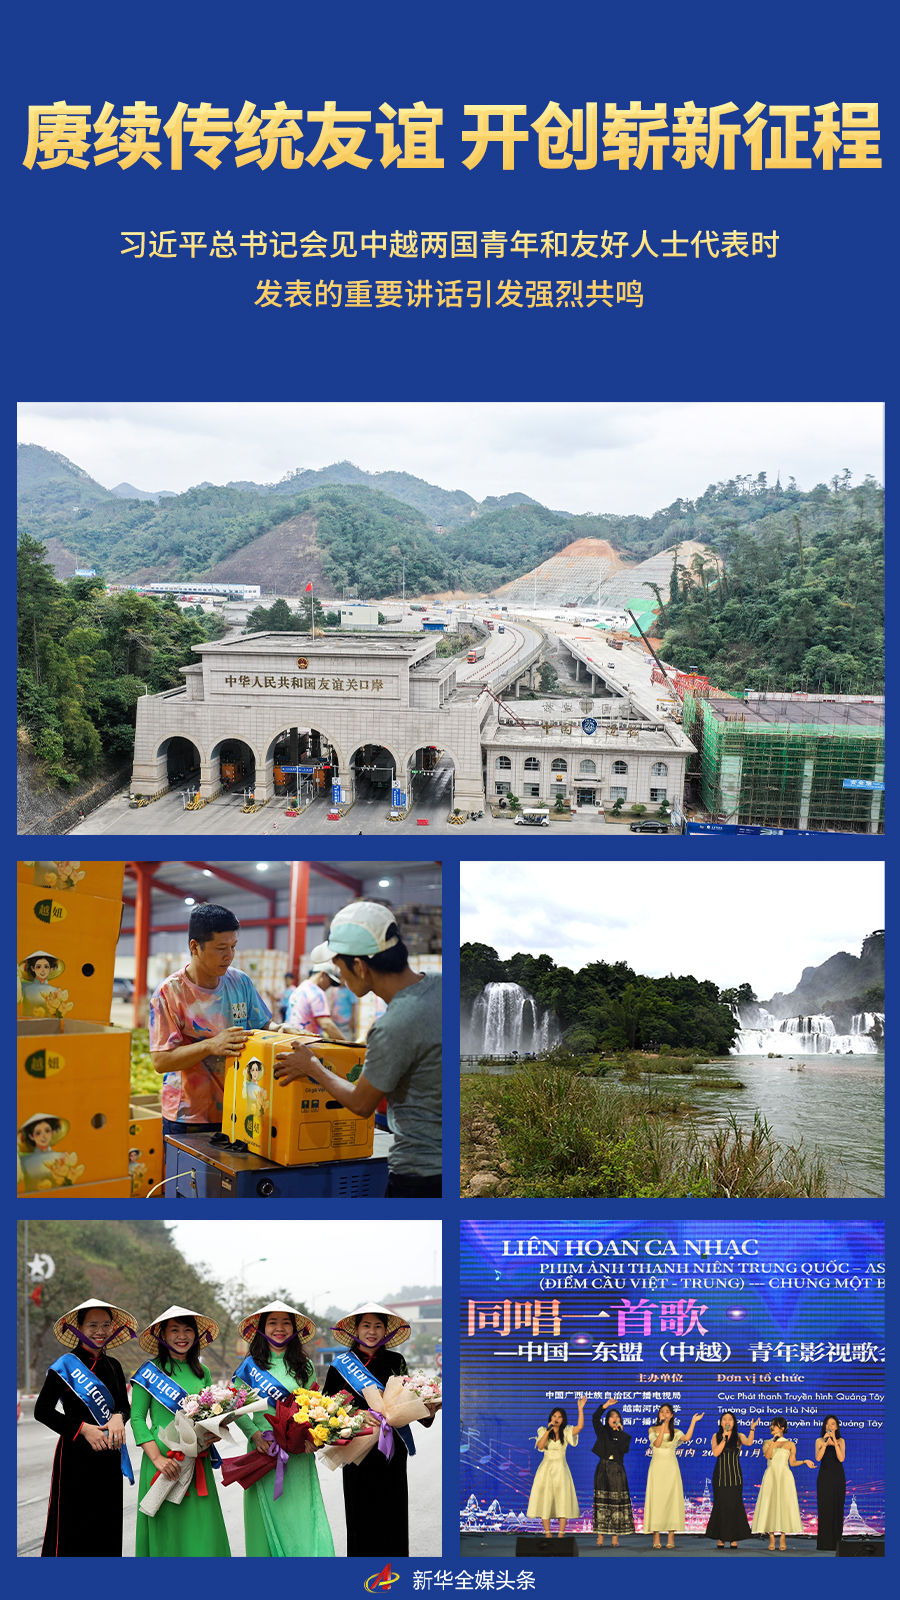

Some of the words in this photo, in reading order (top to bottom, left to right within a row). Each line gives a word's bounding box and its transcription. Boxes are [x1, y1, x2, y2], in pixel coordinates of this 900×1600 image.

[225, 675, 384, 692] 中华人民共和国友谊关口岸
[501, 1236, 560, 1256] LIÊN
[564, 1239, 640, 1256] HOAN
[644, 1239, 680, 1256] CA
[683, 1239, 759, 1259] NHẠC
[539, 1263, 584, 1274] PHIM
[627, 1263, 688, 1274] THANH
[693, 1260, 734, 1274] NIÊN
[738, 1262, 797, 1274] TRUNG
[801, 1259, 849, 1275] QUỐC
[591, 1275, 626, 1289] CẦU
[630, 1276, 668, 1292] VIỆT
[680, 1277, 744, 1290] TRUNG)
[768, 1277, 830, 1289] CHUNG
[834, 1276, 872, 1291] MỘT
[467, 1298, 710, 1337] 同唱一首歌
[71, 1368, 88, 1384] DU
[250, 1367, 264, 1382] DU
[336, 1354, 352, 1364] DU
[346, 1362, 368, 1382] LỊCH
[142, 1368, 159, 1384] DU
[156, 1380, 180, 1400] LỊCH
[638, 1373, 683, 1383] 主办单位
[717, 1374, 742, 1382] Đơn
[774, 1373, 805, 1382] chức
[546, 1391, 682, 1400] 中国广西壮族自治区广播电视局
[718, 1392, 734, 1401] Cục
[738, 1392, 756, 1400] Phát
[758, 1392, 782, 1400] thanh
[622, 1404, 682, 1412] 越南河内学
[766, 1406, 782, 1414] học
[786, 1406, 798, 1414] Hà
